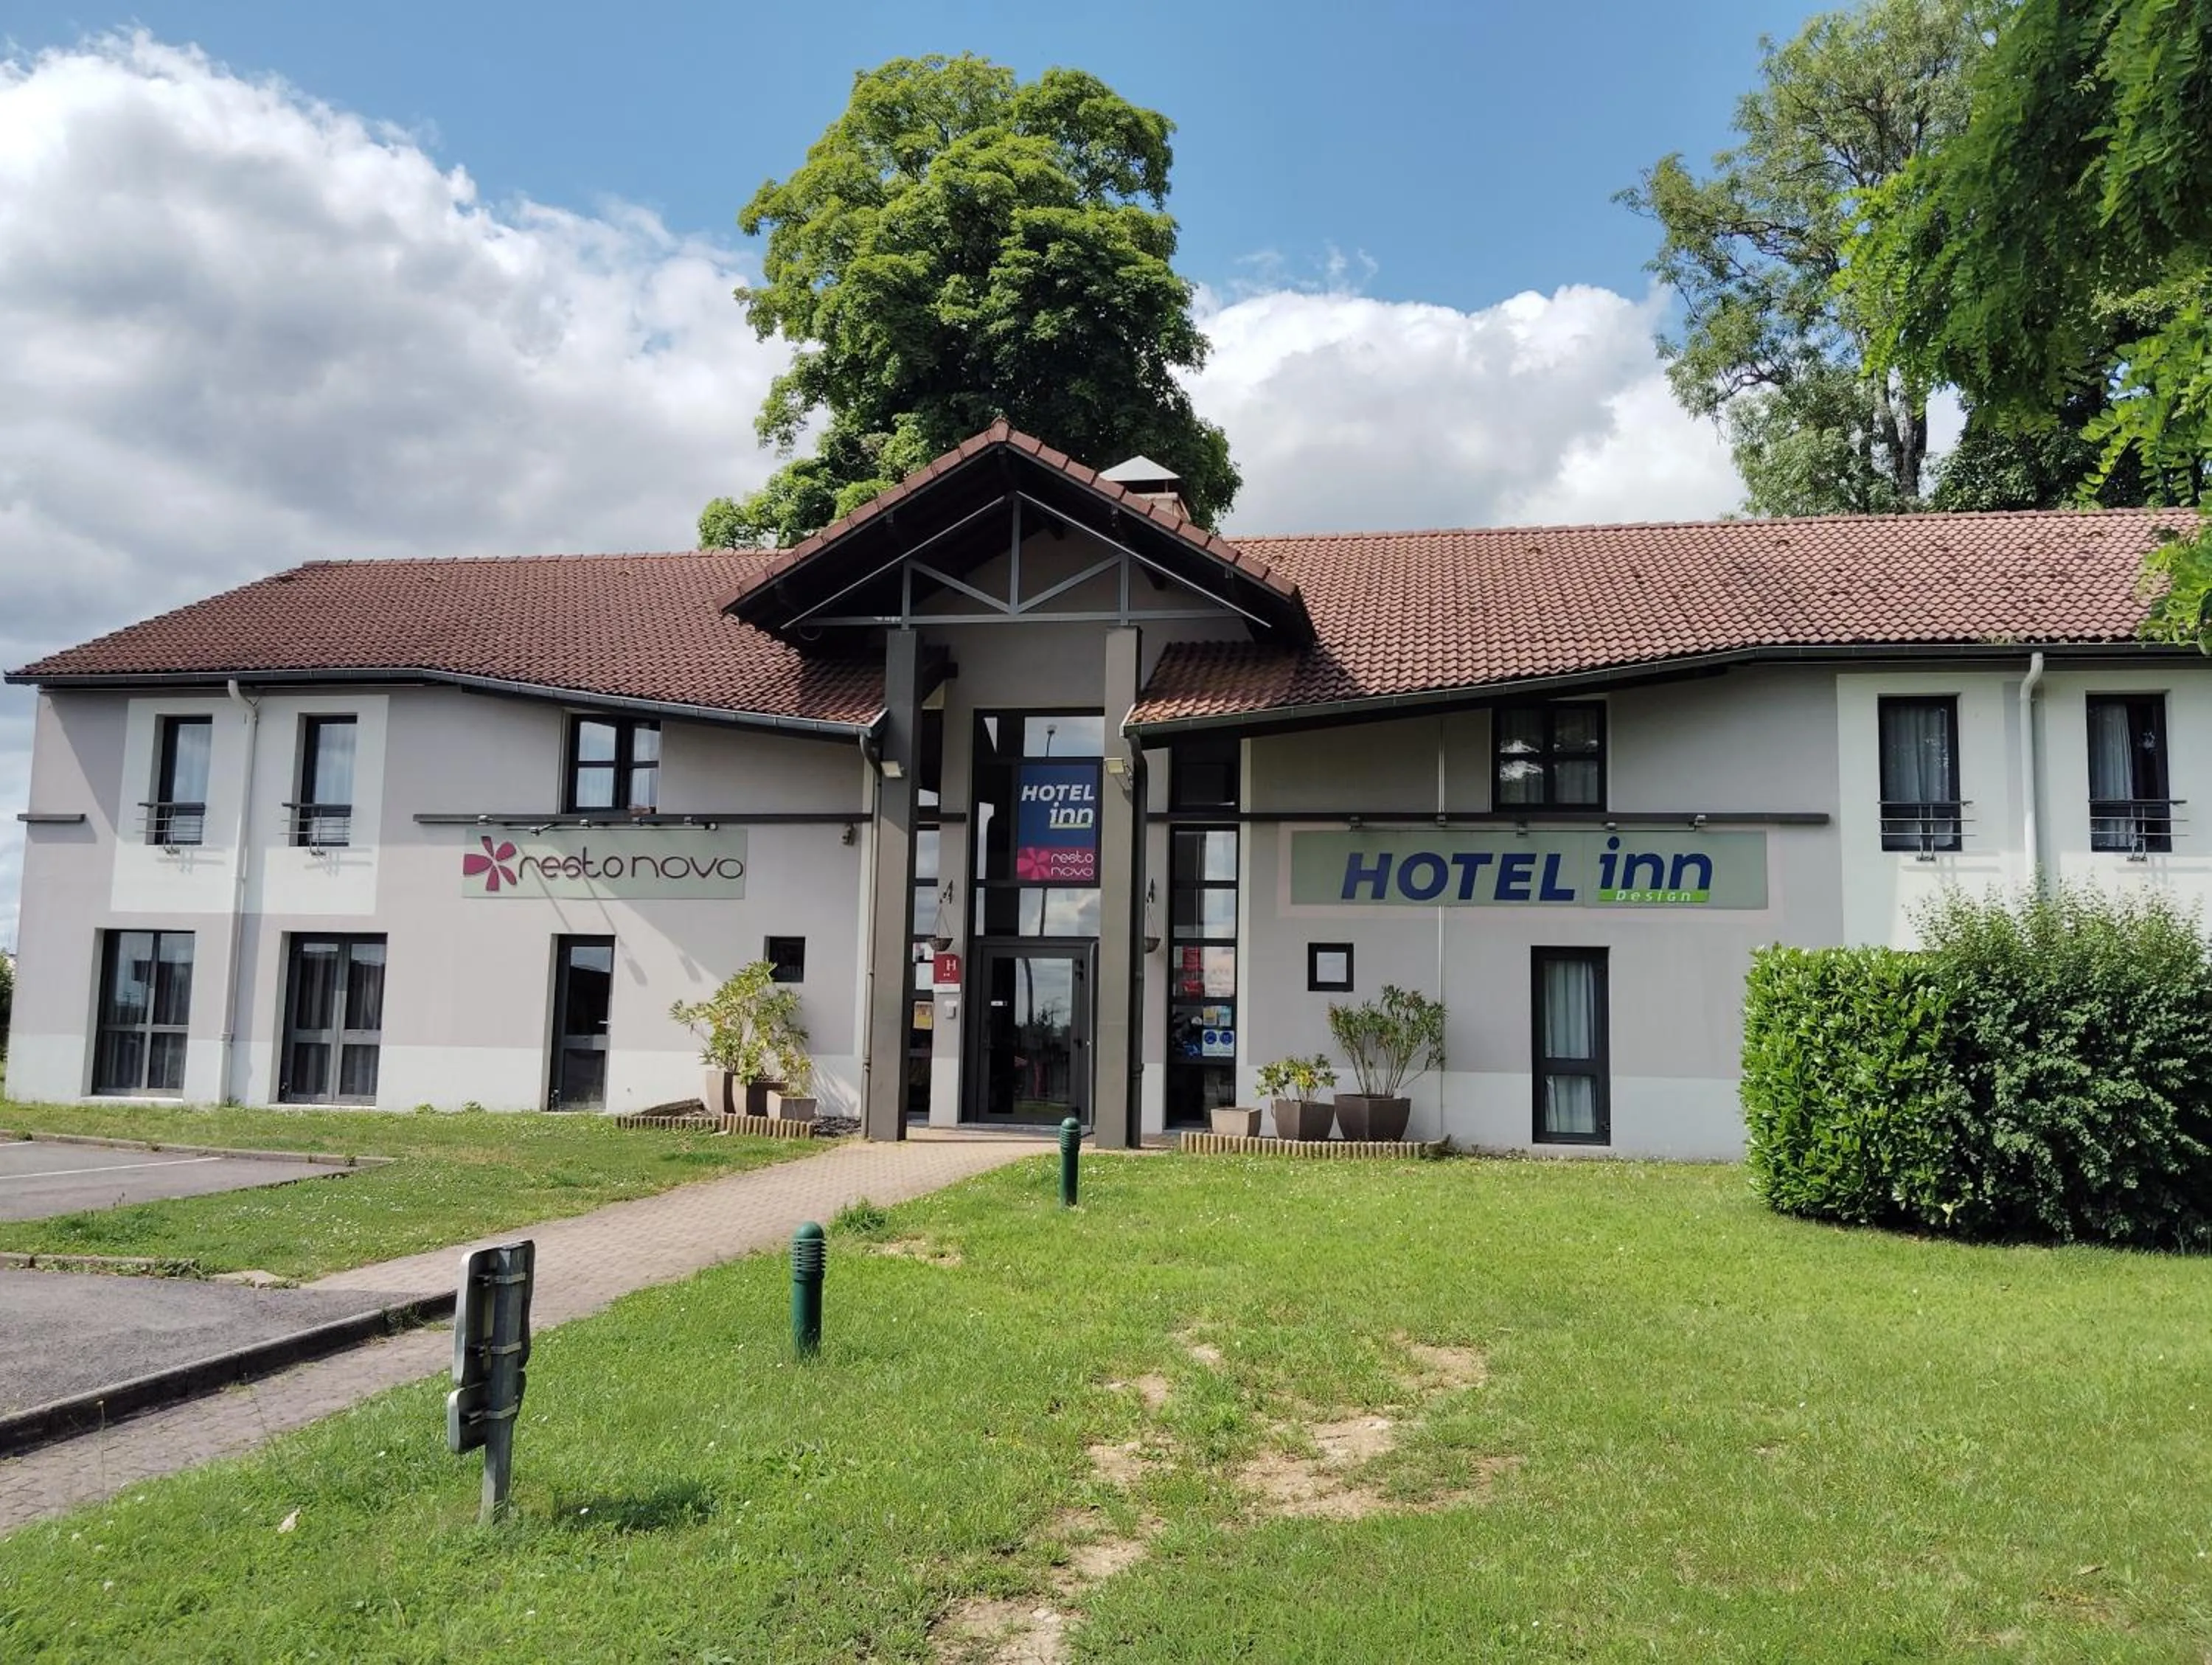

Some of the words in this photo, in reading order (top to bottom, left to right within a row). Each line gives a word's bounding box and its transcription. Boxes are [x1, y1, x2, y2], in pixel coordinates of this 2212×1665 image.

[1021, 785, 1095, 802] HOTEL
[1049, 802, 1094, 824] inn
[1051, 850, 1094, 863] resto
[1051, 866, 1093, 877] novo
[1341, 852, 1576, 900] HOTEL
[1599, 836, 1712, 889] inn
[946, 959, 956, 971] H
